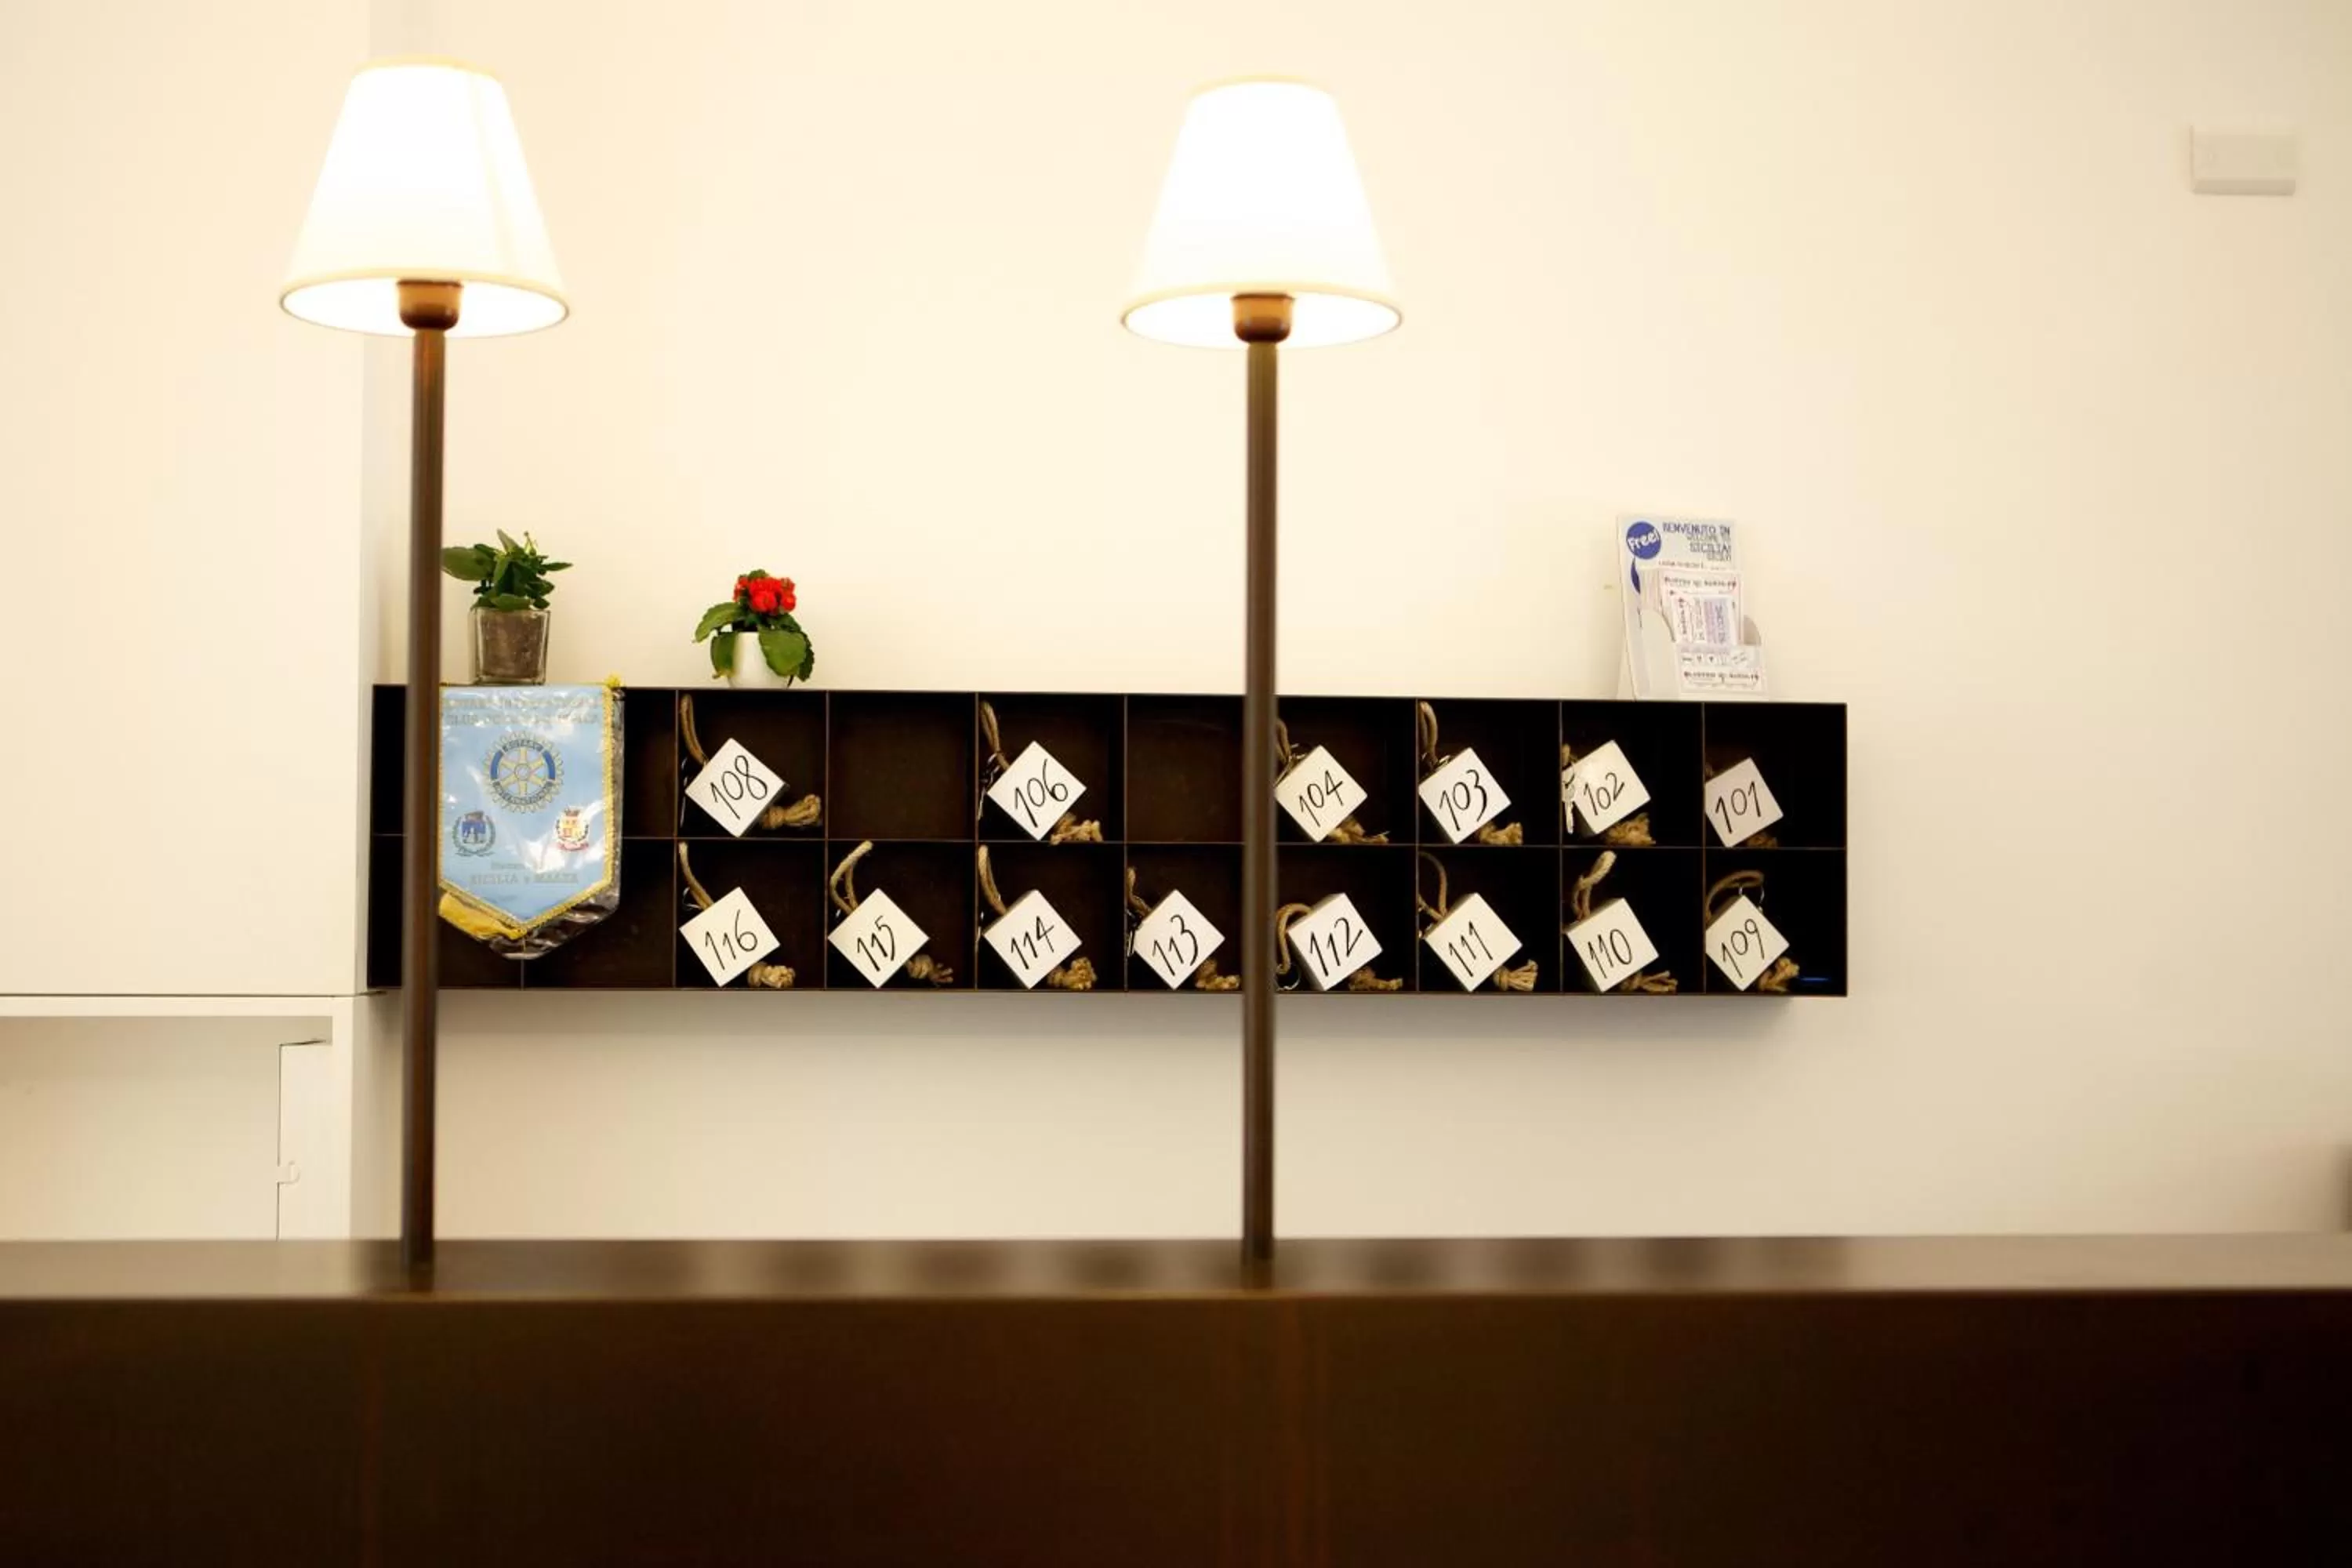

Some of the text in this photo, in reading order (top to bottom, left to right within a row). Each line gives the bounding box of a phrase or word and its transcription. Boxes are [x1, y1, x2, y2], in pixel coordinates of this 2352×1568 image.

[1662, 522, 1716, 535] BENVENUTO
[710, 755, 768, 820] 108
[1014, 758, 1069, 829] 106
[1298, 770, 1344, 827] 104
[1439, 769, 1488, 832] 103
[1583, 771, 1625, 816] 102
[1715, 781, 1762, 834] 101
[705, 909, 758, 971] 116
[857, 915, 895, 972] 115
[1011, 916, 1054, 971] 114
[1152, 914, 1199, 977] 113
[1309, 916, 1363, 978] 112
[1448, 920, 1494, 978] 111
[1587, 928, 1632, 979] 110
[1721, 918, 1765, 979] 109
